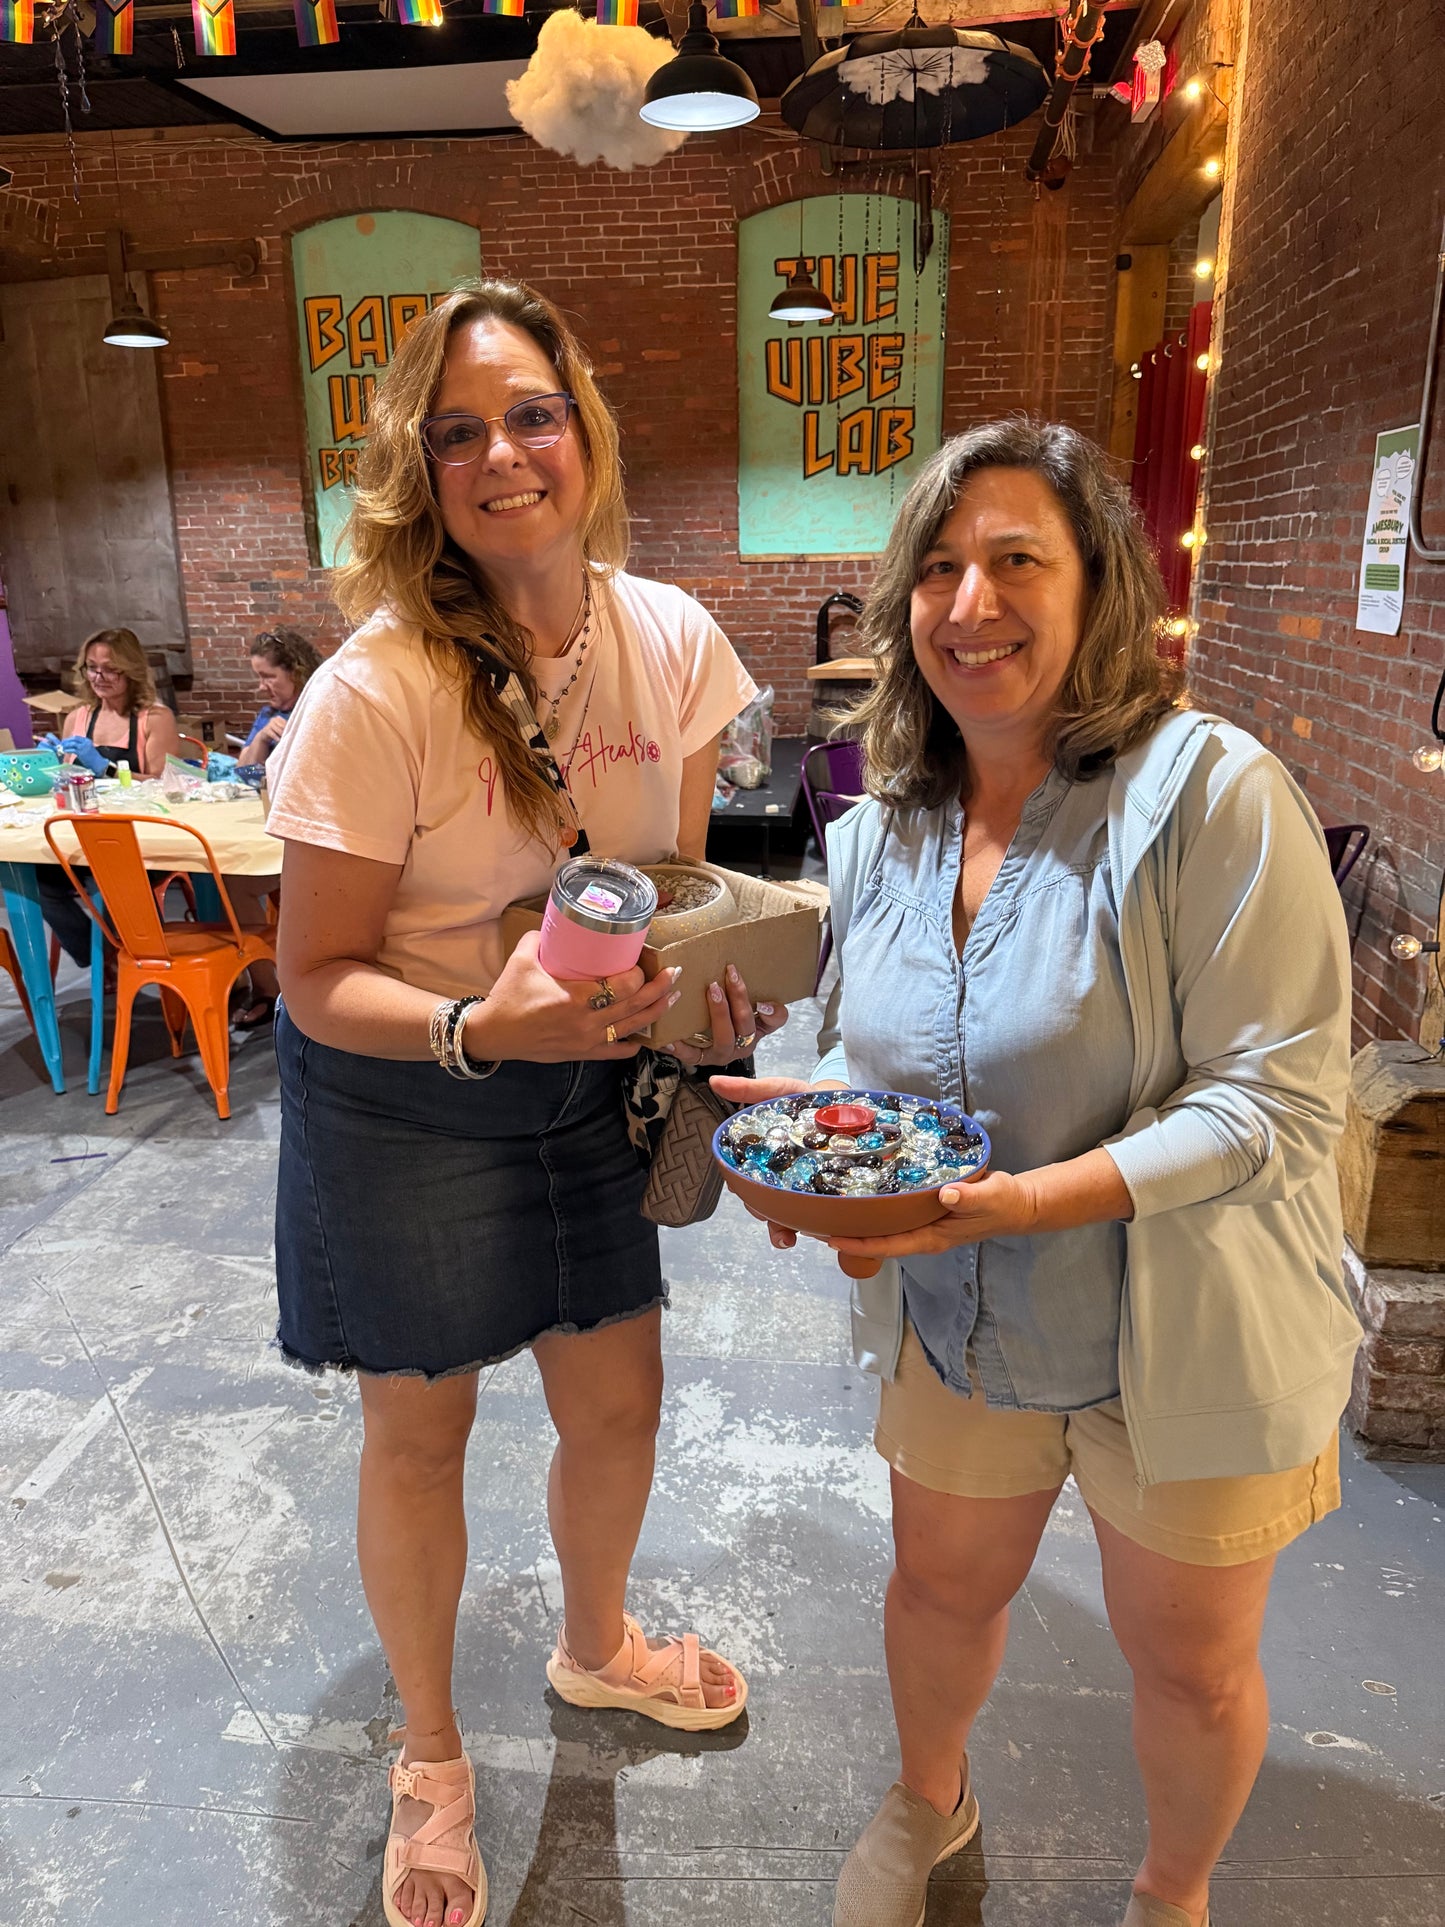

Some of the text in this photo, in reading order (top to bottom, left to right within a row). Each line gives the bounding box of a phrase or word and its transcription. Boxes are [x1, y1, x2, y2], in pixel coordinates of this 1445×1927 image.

[774, 251, 900, 327] THE
[304, 293, 450, 373] BAR
[765, 333, 905, 406] VIBE
[803, 407, 915, 480] LAB
[1371, 519, 1404, 535] AMESBURY
[577, 721, 646, 788] Heals
